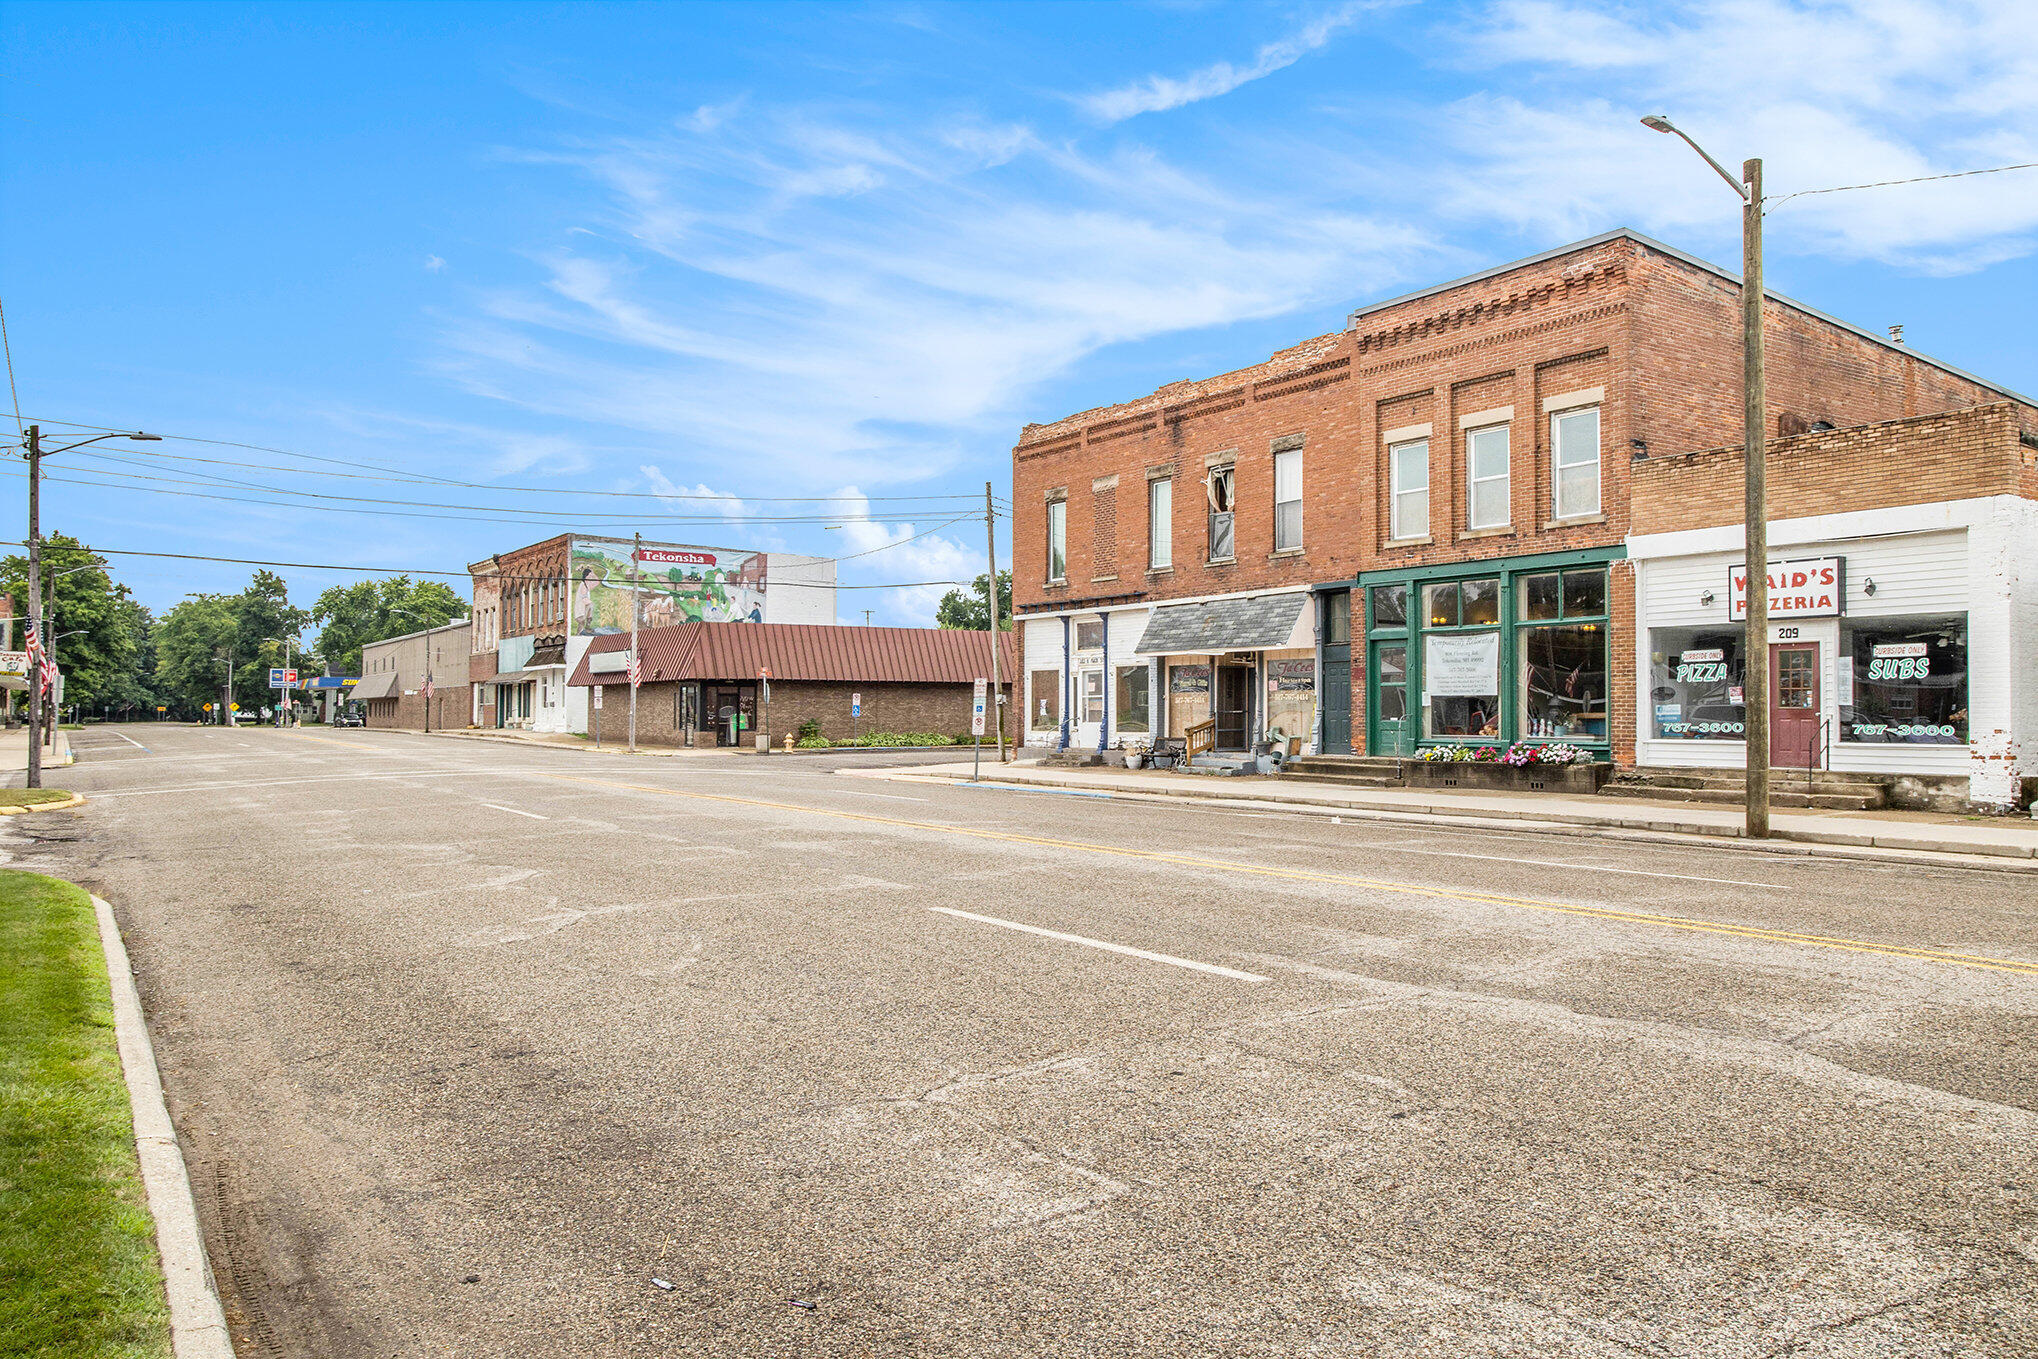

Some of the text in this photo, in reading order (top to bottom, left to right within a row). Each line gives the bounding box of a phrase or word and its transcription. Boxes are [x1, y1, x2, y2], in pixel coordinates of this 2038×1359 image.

[643, 551, 705, 563] Tekonsha
[1736, 595, 1832, 612] PZERIA
[1779, 628, 1799, 639] 209
[1875, 645, 1925, 655] CURBSIDE ONLY
[1677, 663, 1727, 682] PIZZA
[1868, 658, 1930, 680] SUBS
[1663, 722, 1744, 733] 767-3600
[1852, 724, 1955, 736] 767-3600
